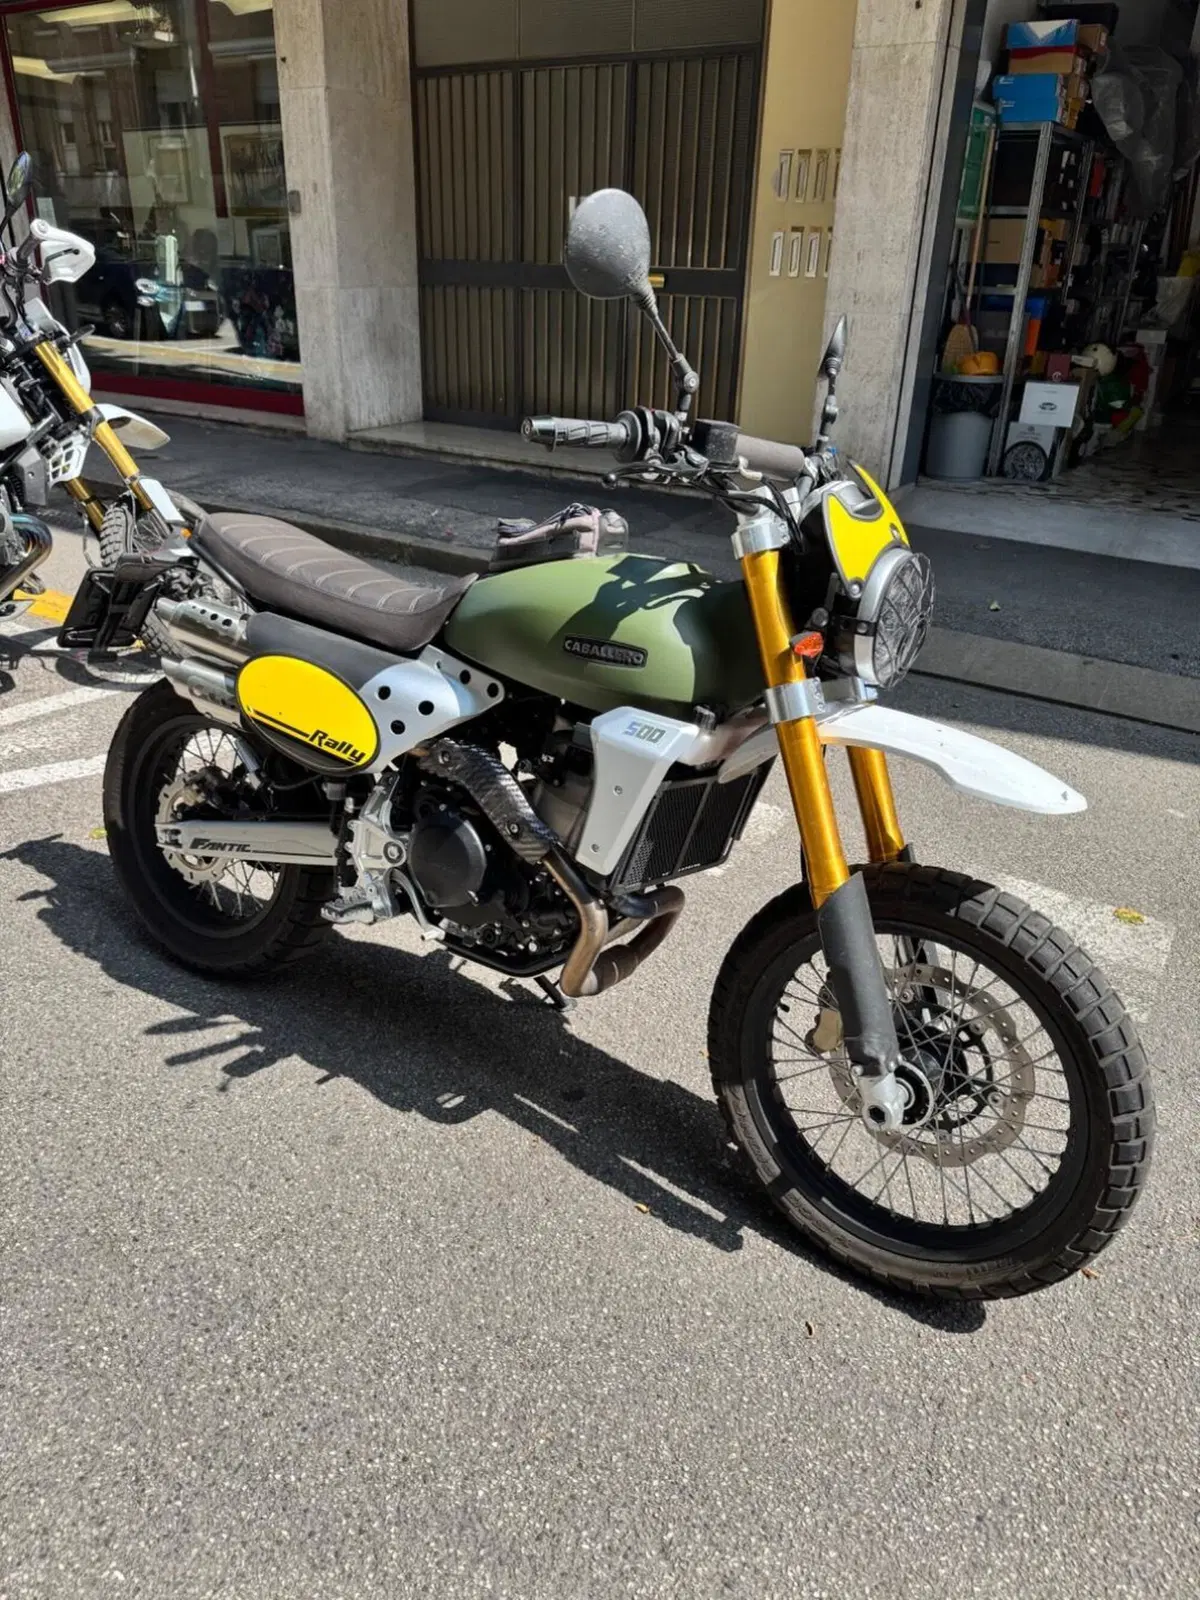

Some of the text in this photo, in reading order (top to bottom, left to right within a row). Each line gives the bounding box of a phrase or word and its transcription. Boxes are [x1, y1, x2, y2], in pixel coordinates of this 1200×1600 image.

[564, 639, 645, 664] CABALLERO
[622, 721, 667, 744] 500
[309, 729, 367, 763] Rally
[190, 837, 252, 853] FANTIC
